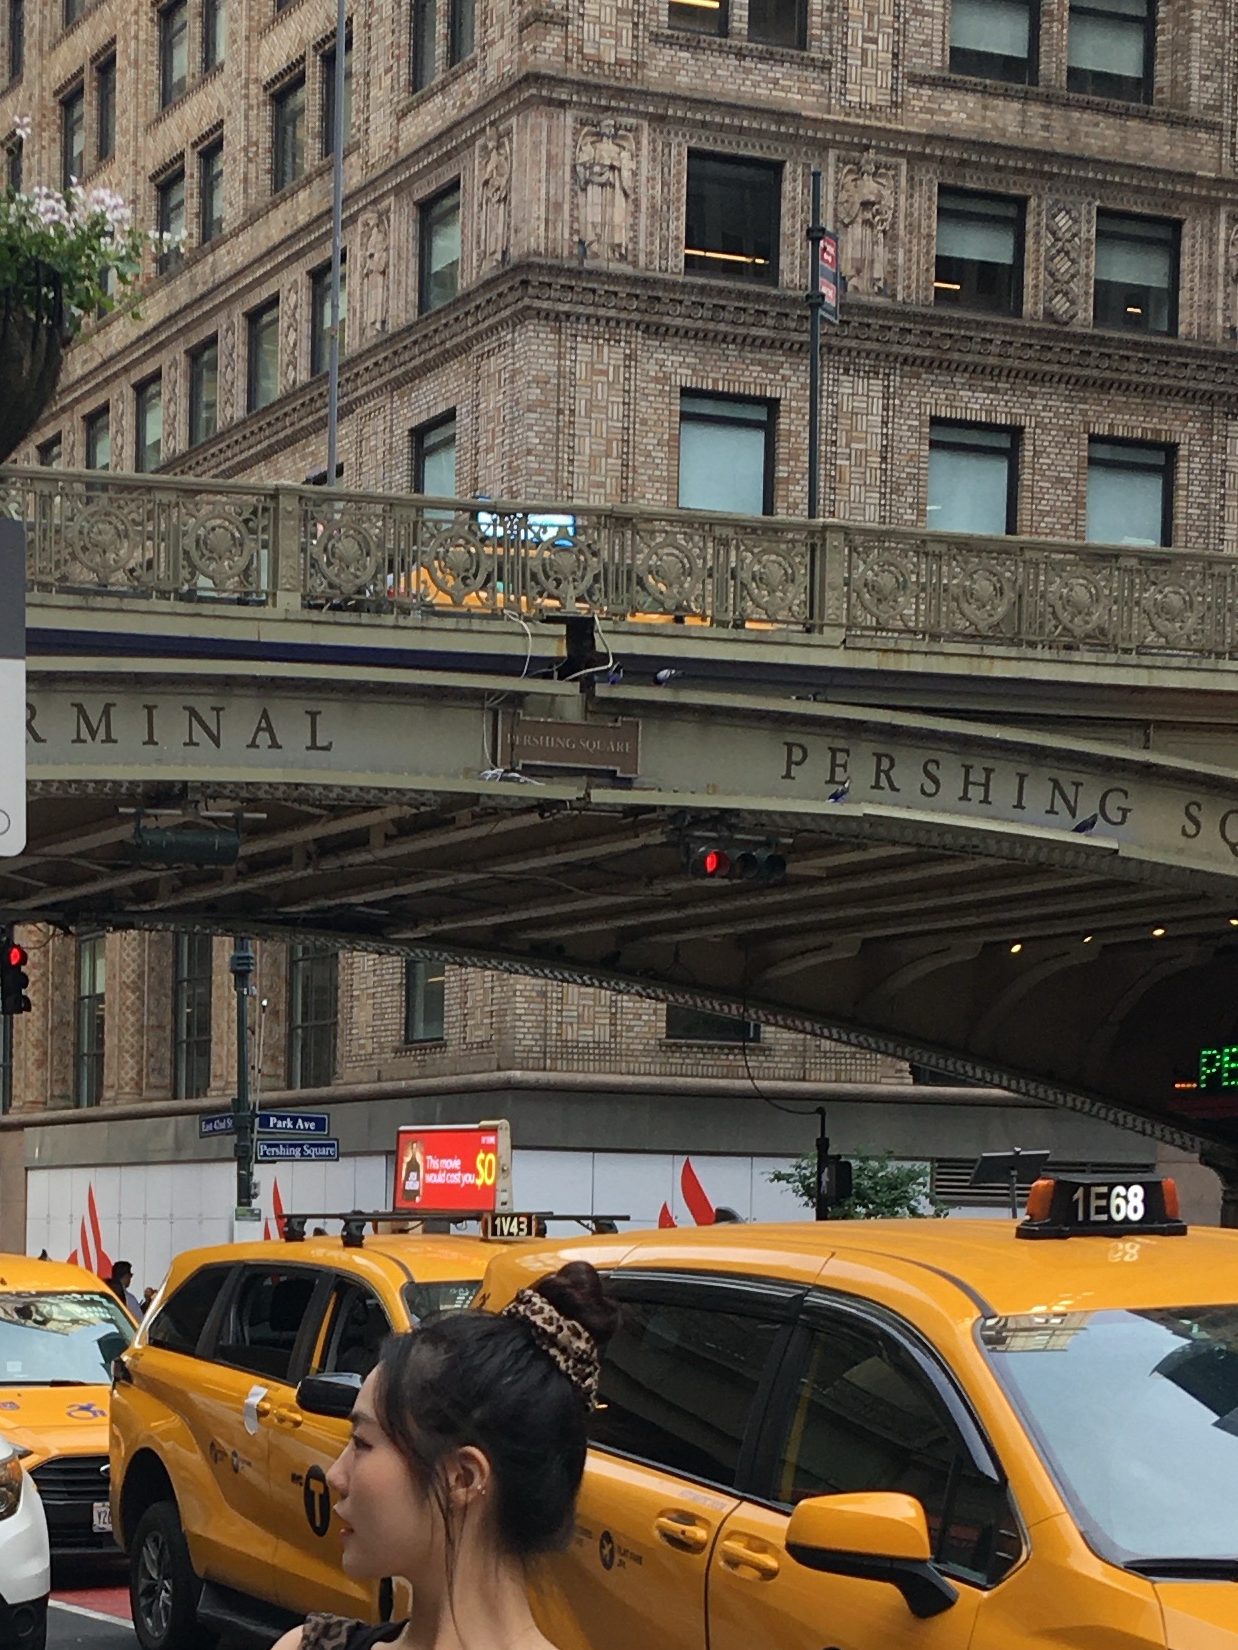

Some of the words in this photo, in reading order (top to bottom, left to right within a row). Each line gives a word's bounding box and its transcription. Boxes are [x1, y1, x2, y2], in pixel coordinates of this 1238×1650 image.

[26, 702, 333, 751] RMINAL
[579, 739, 631, 753] SQUARE
[781, 741, 1133, 827] PERSHING
[269, 1116, 293, 1129] Park
[295, 1118, 316, 1130] Ave
[259, 1144, 301, 1157] Pershing
[303, 1144, 335, 1157] Square
[426, 1155, 439, 1170] This
[440, 1155, 461, 1170] movie
[476, 1149, 496, 1190] $0
[425, 1170, 446, 1184] would
[446, 1171, 460, 1184] cost
[461, 1173, 475, 1188] you
[1072, 1184, 1145, 1222] 1E68
[495, 1216, 528, 1237] 1V43
